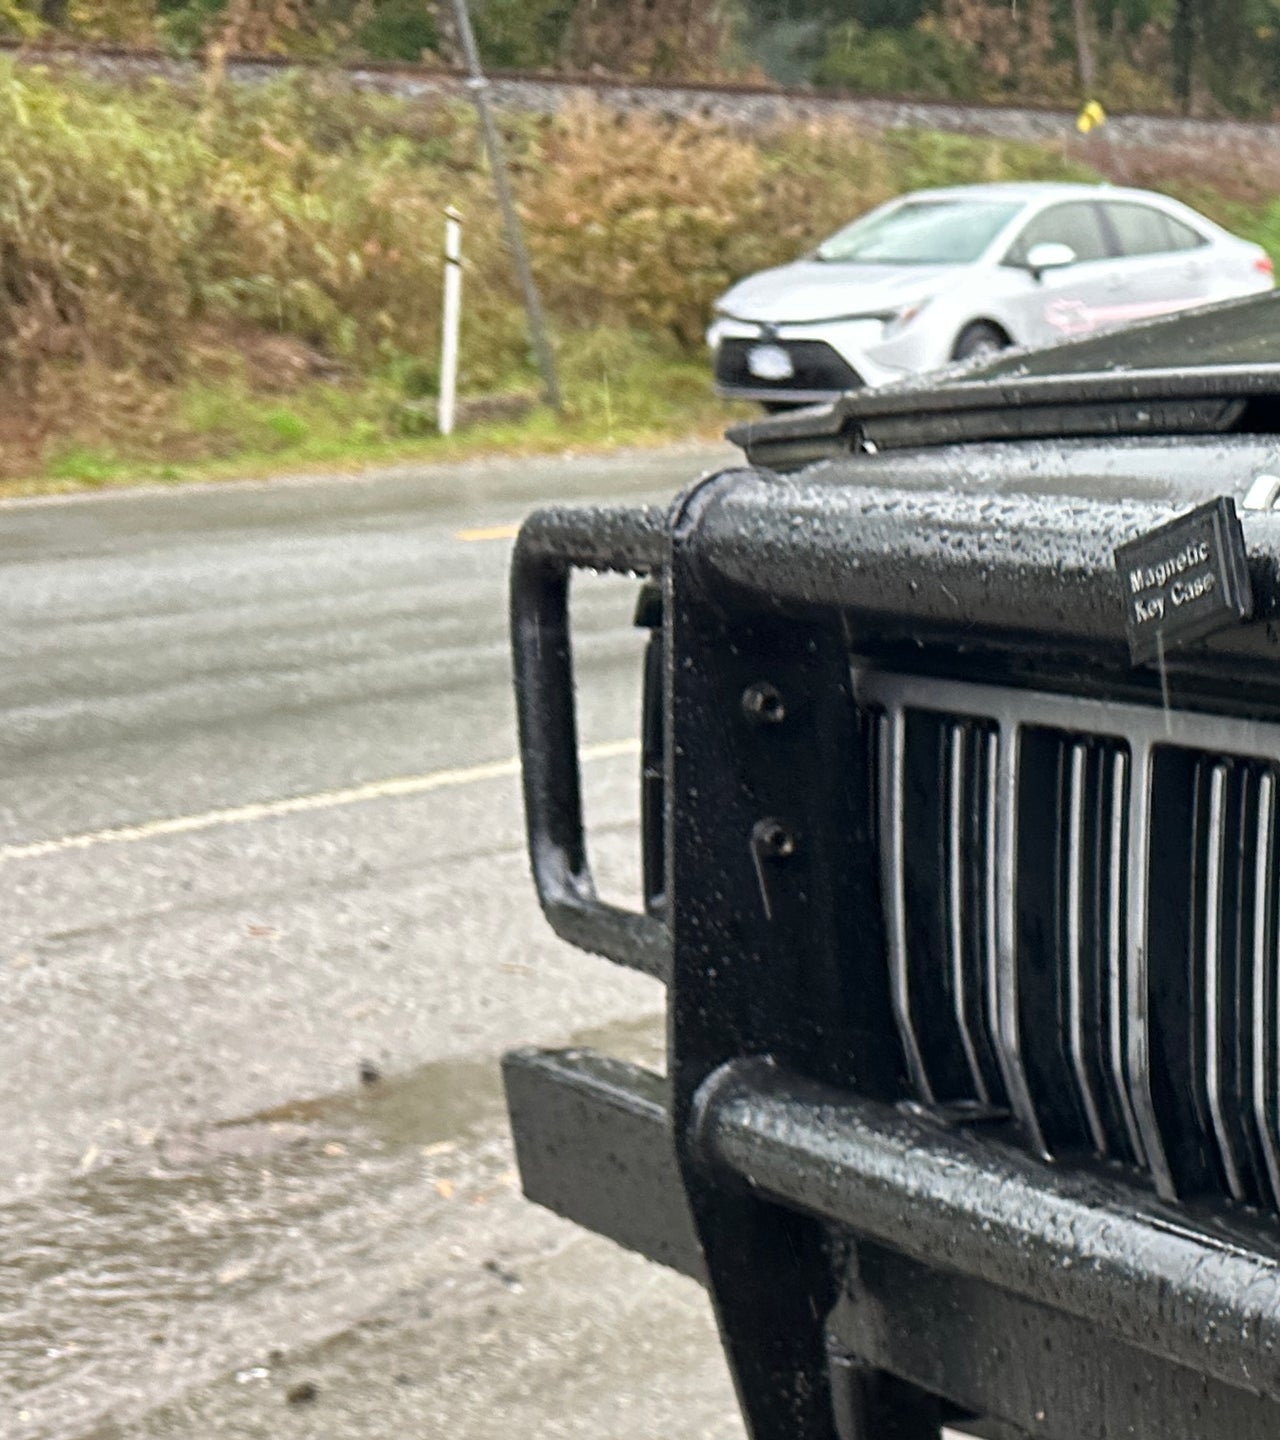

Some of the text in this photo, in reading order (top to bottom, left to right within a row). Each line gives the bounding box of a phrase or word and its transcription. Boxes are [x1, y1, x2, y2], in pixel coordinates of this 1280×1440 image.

[1129, 540, 1209, 593] Magnetic
[1134, 571, 1216, 625] Key Case
